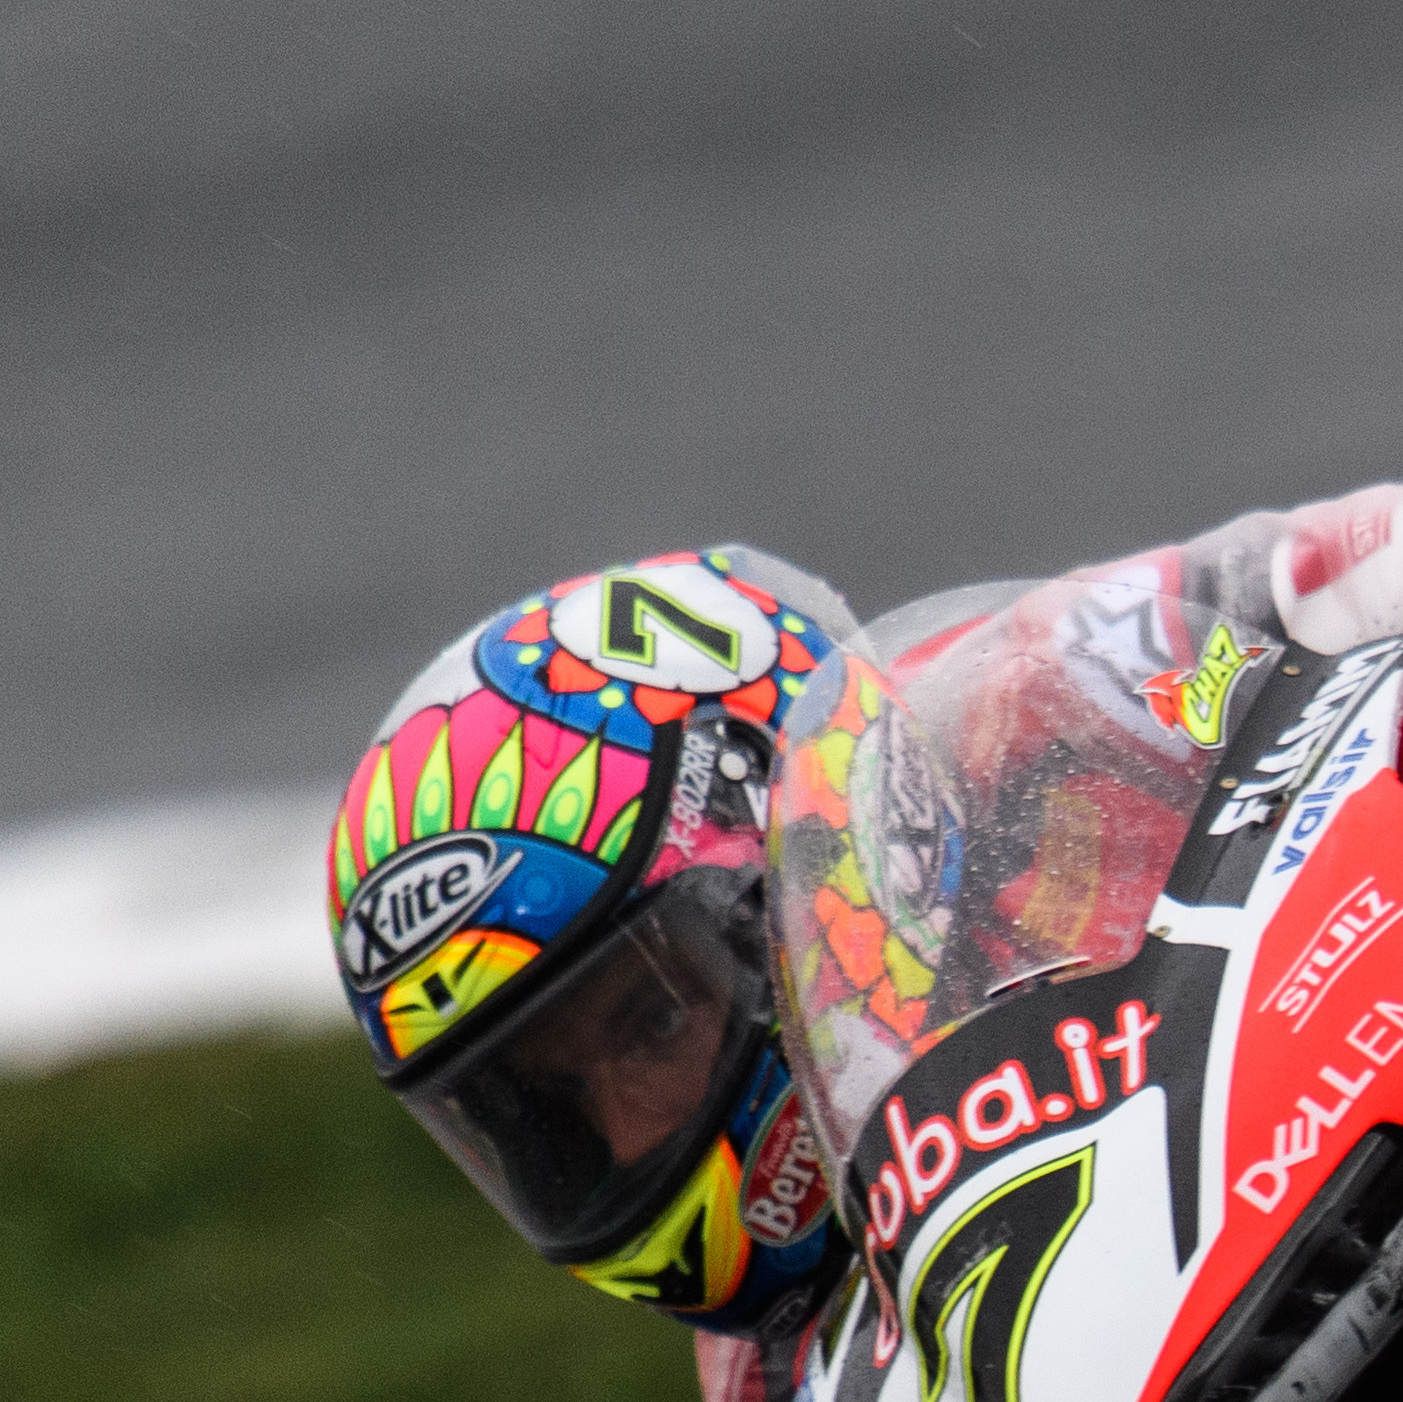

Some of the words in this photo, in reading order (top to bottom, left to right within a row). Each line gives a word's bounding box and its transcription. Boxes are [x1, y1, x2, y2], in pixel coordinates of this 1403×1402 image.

[600, 576, 742, 672] 7
[1272, 728, 1377, 876] valsir
[348, 862, 472, 977] X-lite
[1276, 888, 1396, 1017] STULZ
[1233, 1065, 1376, 1214] DELL
